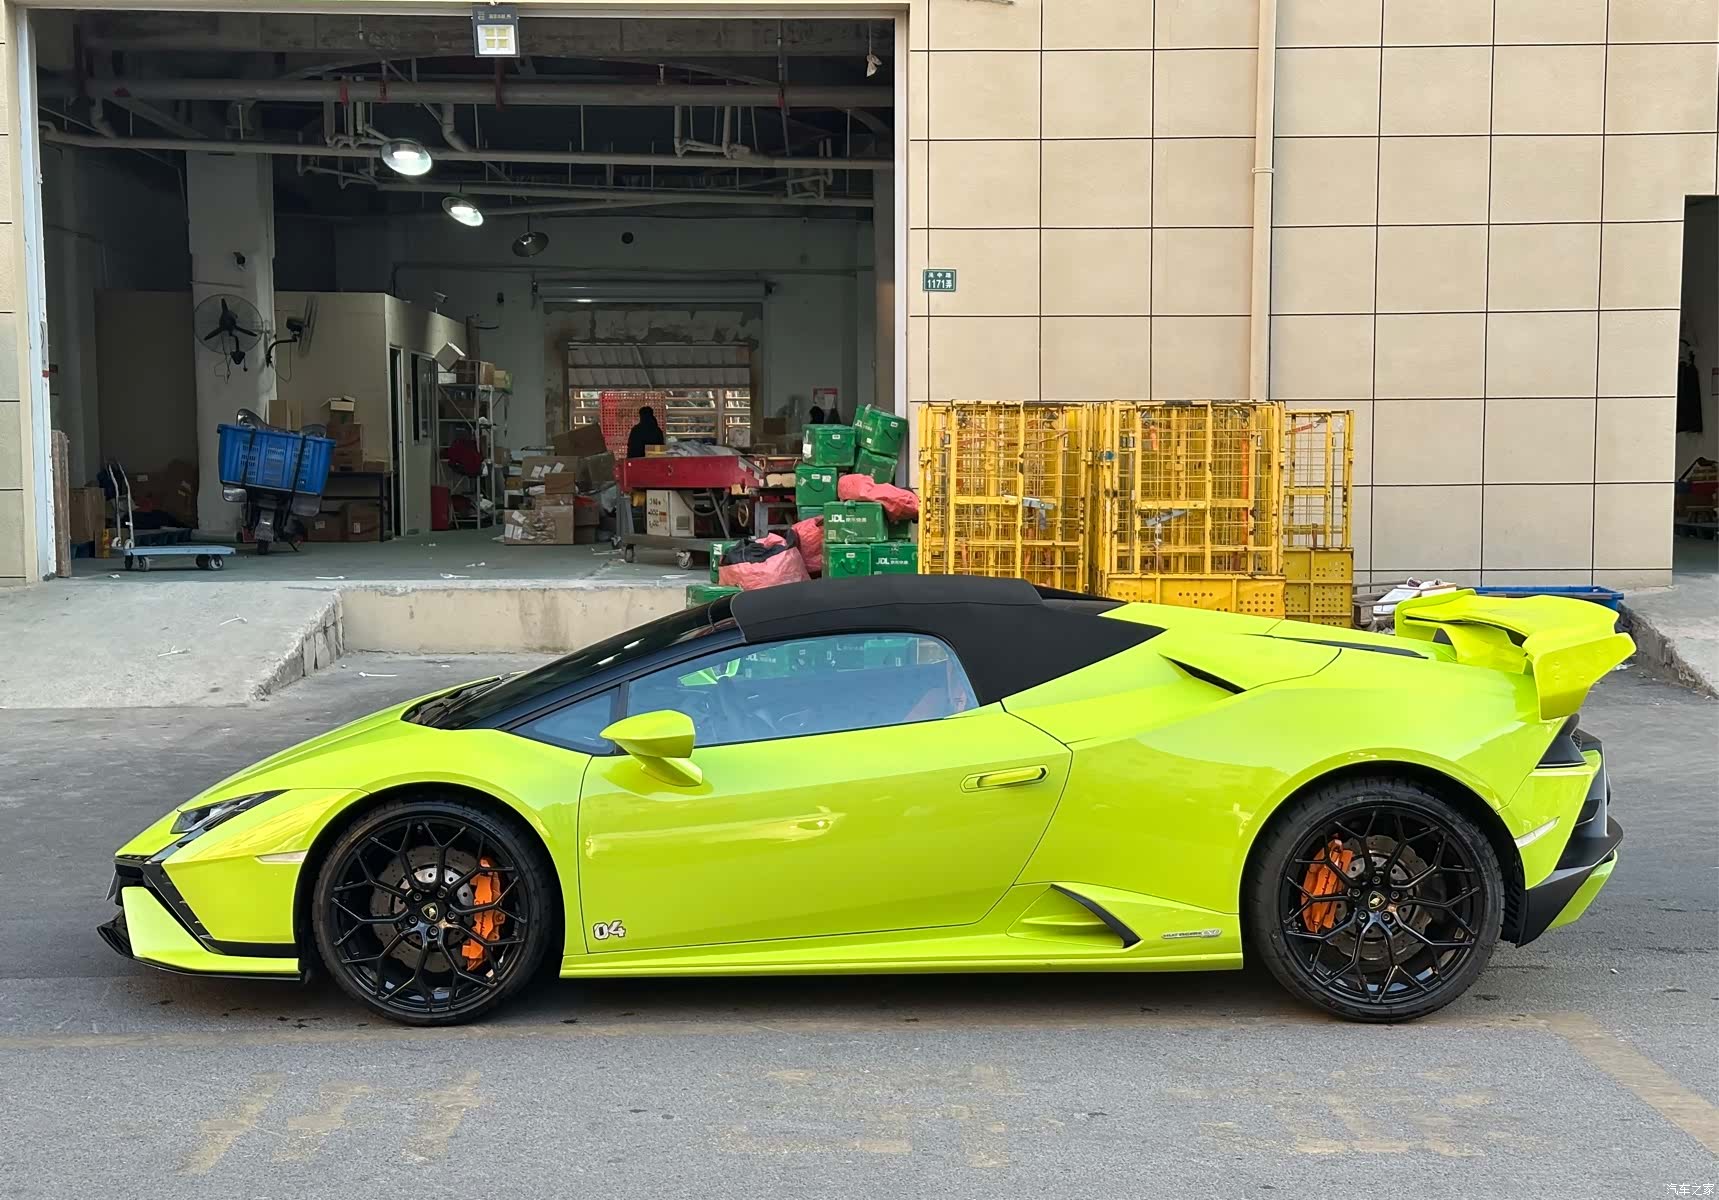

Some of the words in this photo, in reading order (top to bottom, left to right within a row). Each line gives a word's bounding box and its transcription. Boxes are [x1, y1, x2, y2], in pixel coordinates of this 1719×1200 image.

[828, 514, 845, 523] JDL
[876, 557, 890, 565] JDL
[592, 919, 627, 940] 04
